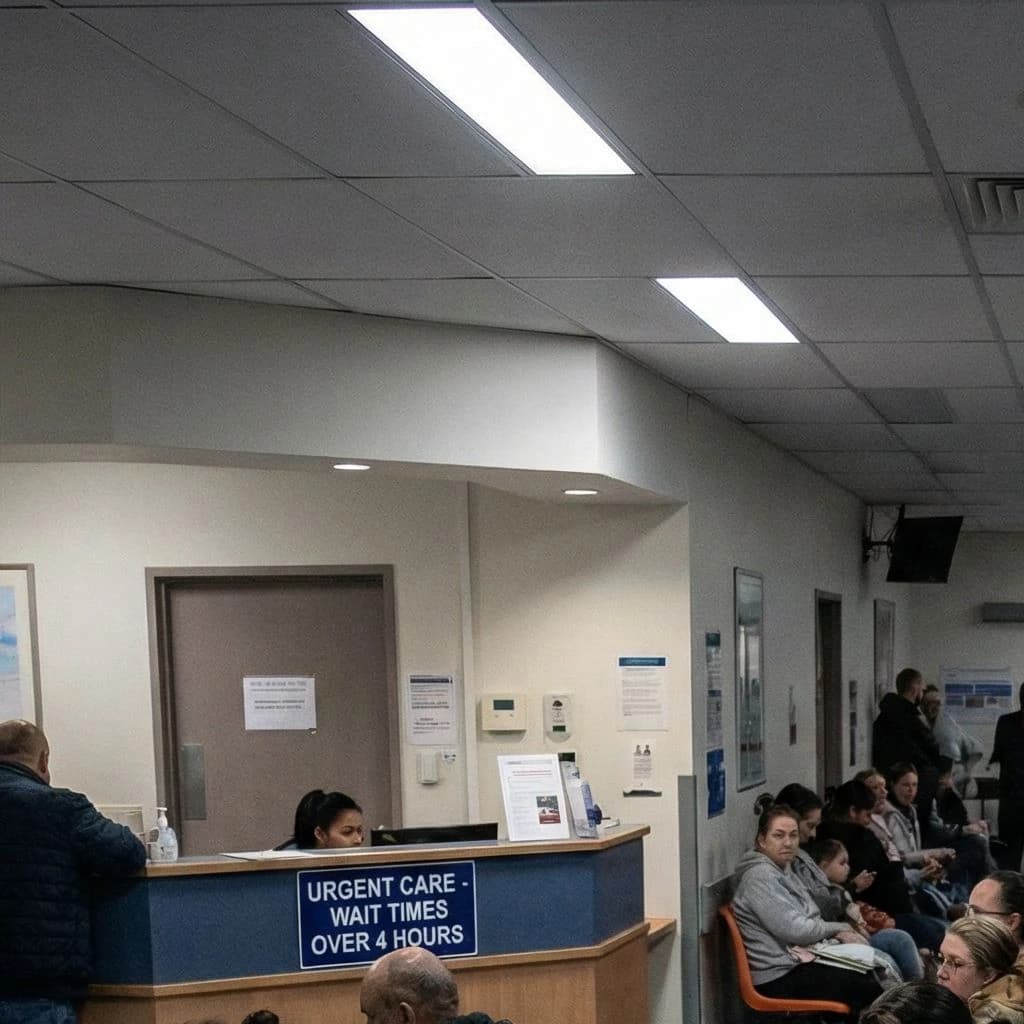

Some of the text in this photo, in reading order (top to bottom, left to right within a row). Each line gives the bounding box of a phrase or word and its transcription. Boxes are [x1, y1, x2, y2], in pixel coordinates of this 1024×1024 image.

[308, 877, 394, 902] URGENT
[400, 873, 456, 895] CARE
[330, 900, 449, 927] WAIT TIMES
[311, 924, 464, 955] OVER 4 HOURS
